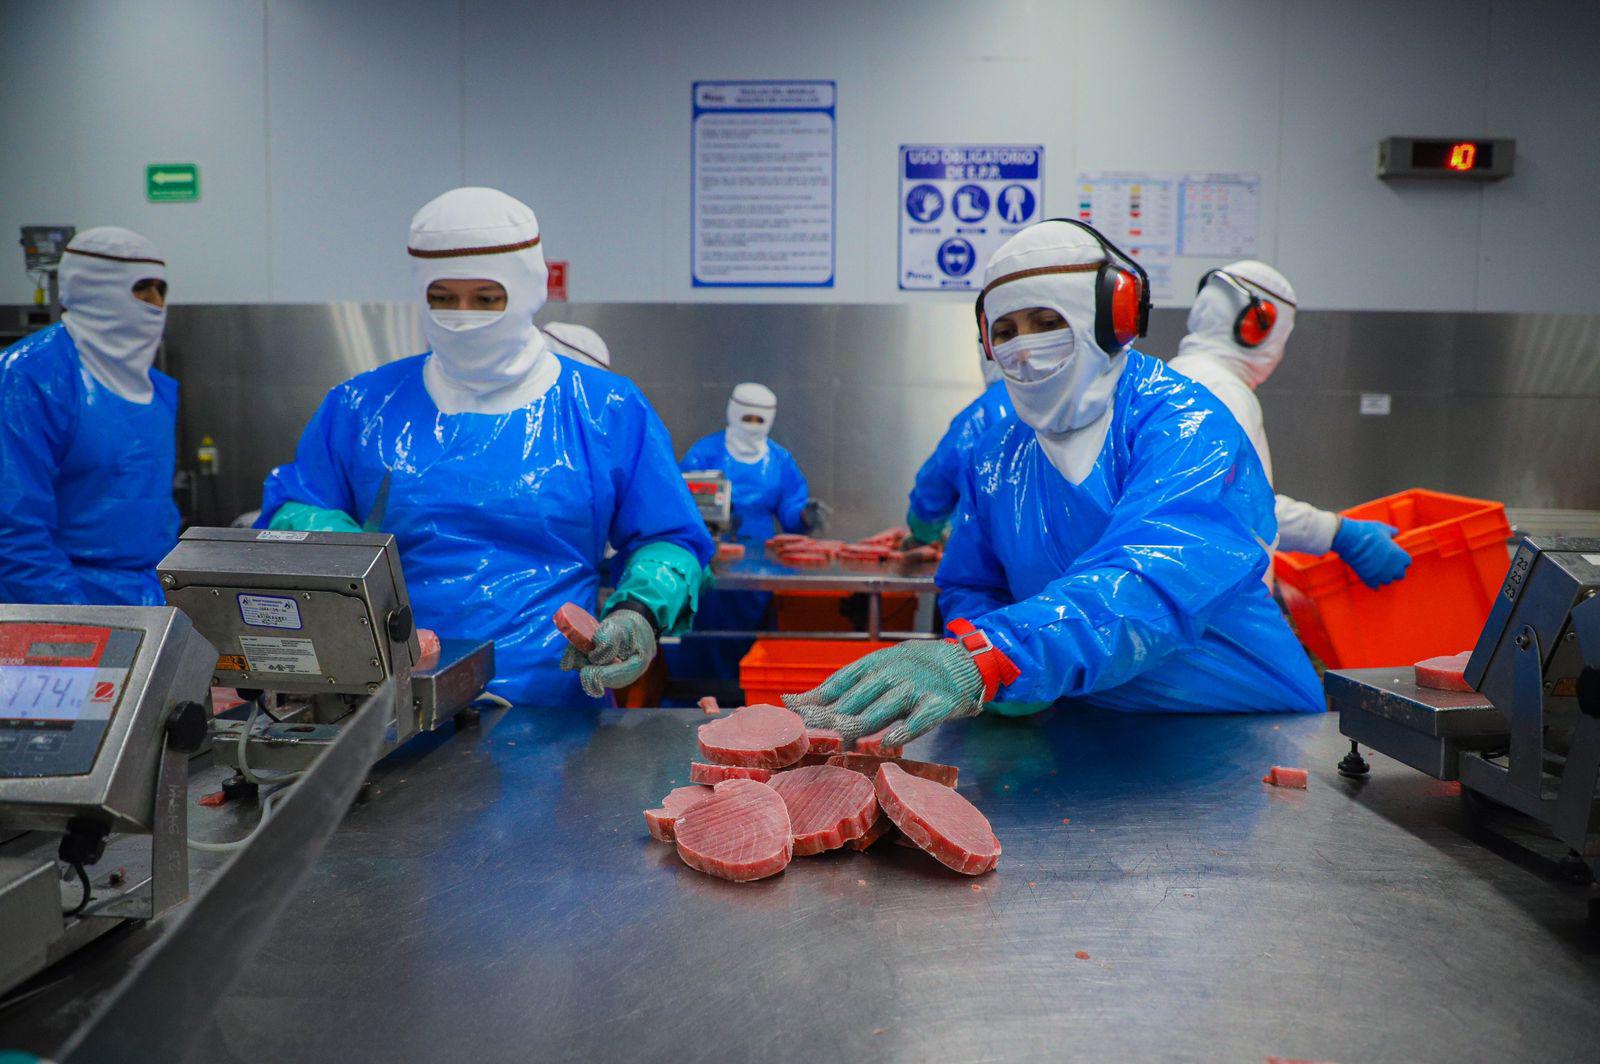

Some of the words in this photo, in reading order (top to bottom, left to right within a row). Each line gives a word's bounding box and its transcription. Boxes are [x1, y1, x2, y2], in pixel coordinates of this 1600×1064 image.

[909, 150, 940, 165] USO
[941, 150, 1036, 165] OBLIGATORIO
[1517, 558, 1528, 570] 23
[1511, 571, 1521, 584] 23
